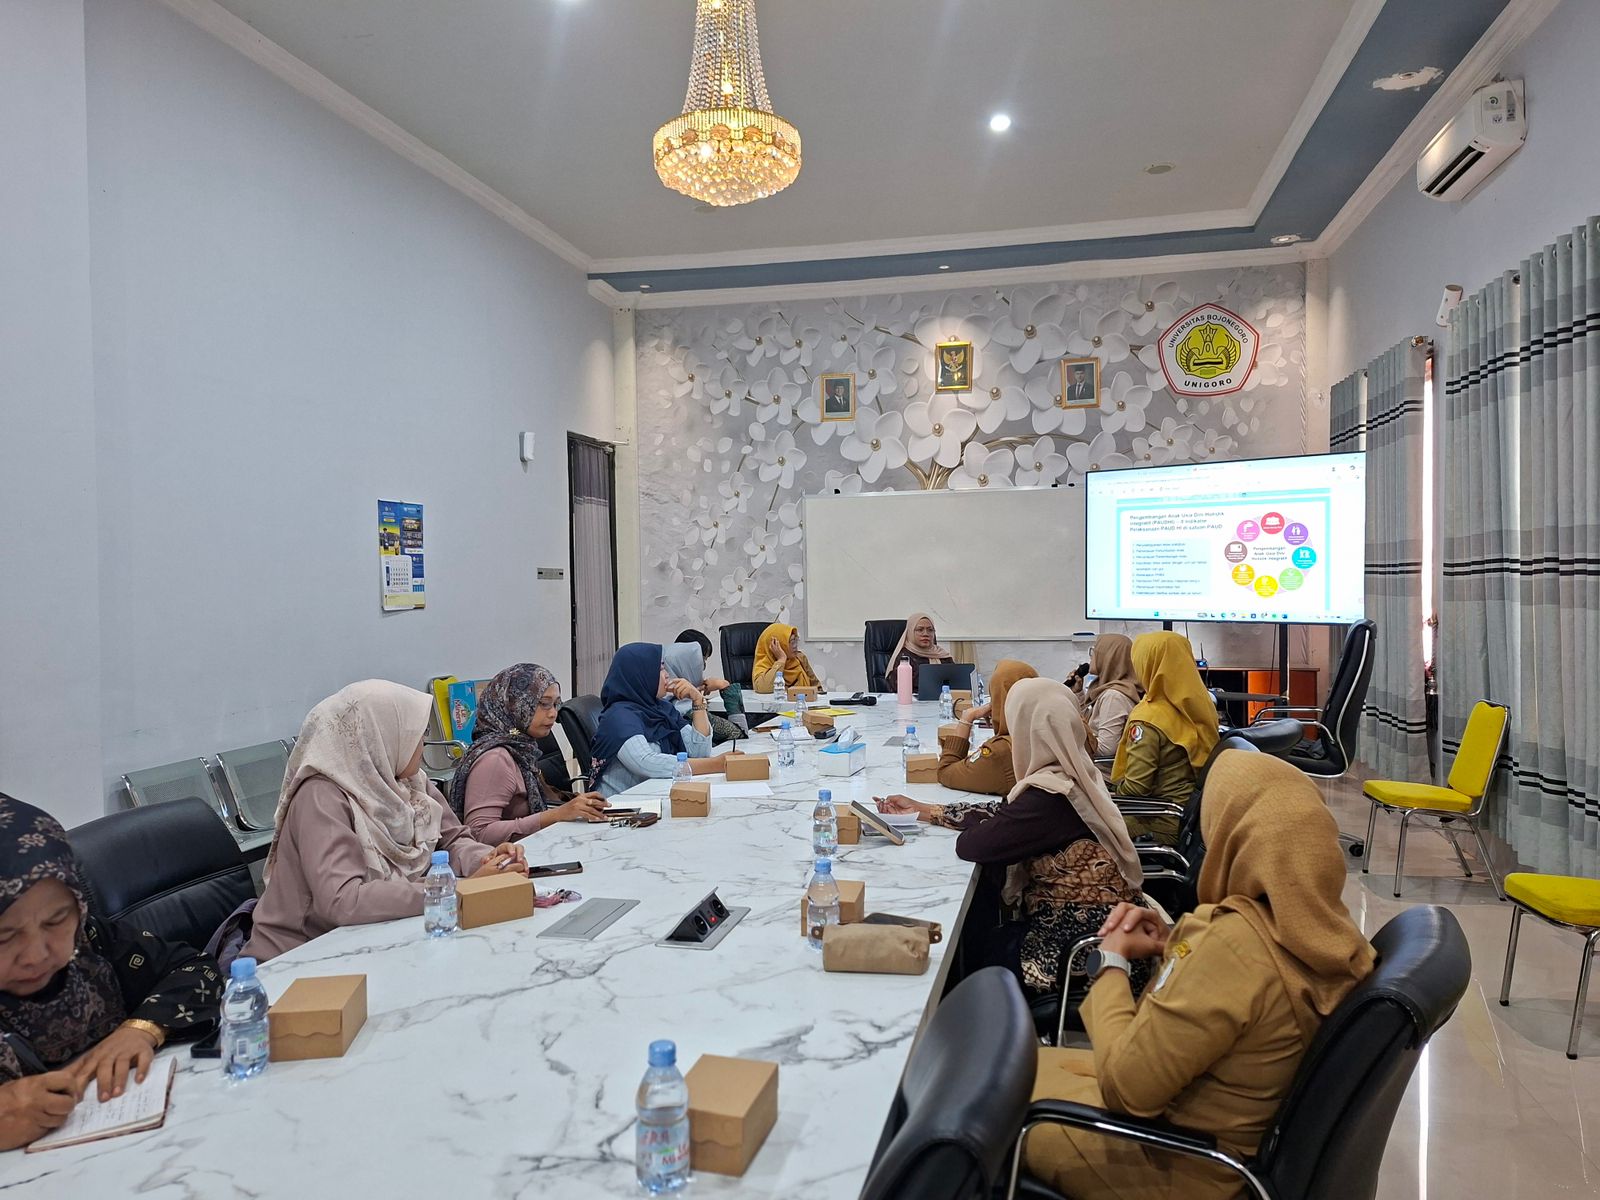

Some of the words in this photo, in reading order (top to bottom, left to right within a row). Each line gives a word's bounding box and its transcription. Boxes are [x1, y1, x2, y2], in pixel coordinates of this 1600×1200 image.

[1168, 314, 1205, 348] UNIVERSITAS
[1206, 314, 1249, 344] BOJONEGORO
[1184, 378, 1232, 388] UNIGORO
